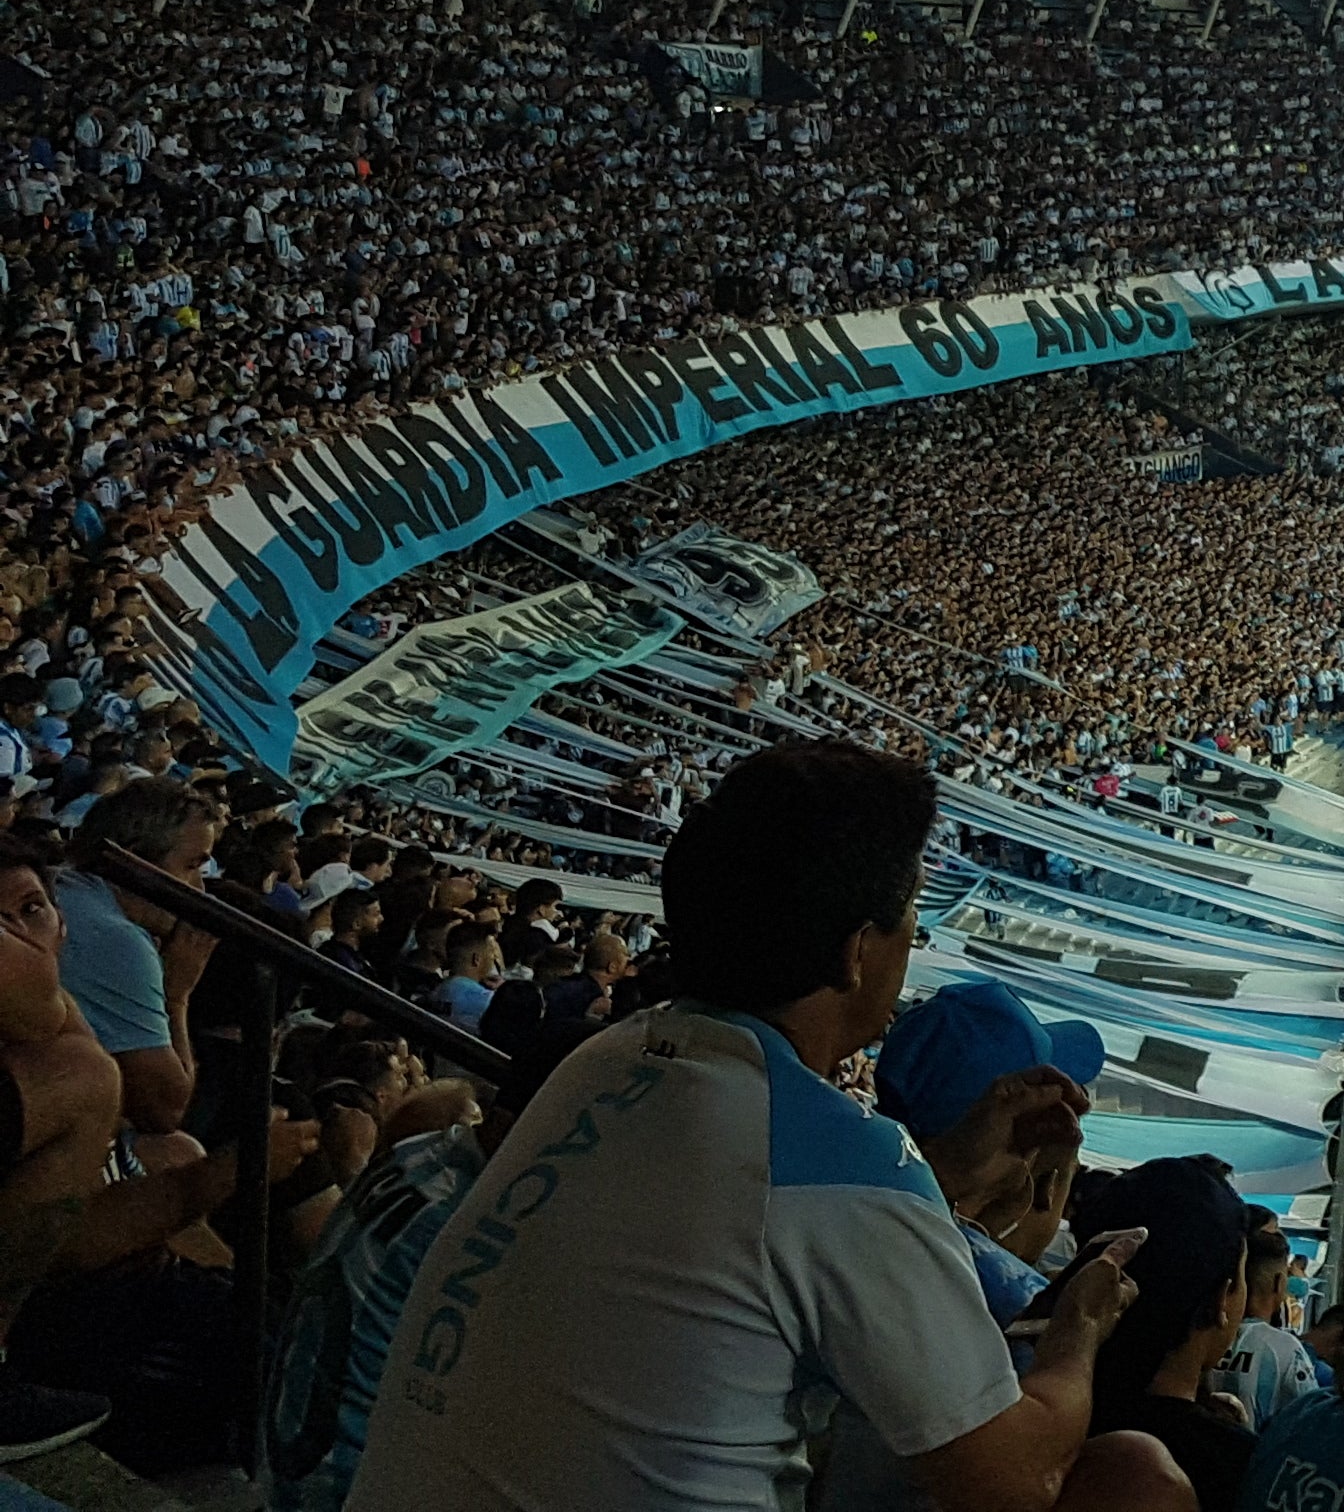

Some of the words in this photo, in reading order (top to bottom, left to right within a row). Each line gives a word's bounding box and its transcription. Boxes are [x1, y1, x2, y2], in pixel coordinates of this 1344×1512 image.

[243, 387, 563, 594] GUARDIA
[540, 314, 902, 468] IMPERIAL
[899, 300, 1000, 378] 60
[414, 1065, 664, 1376] RACING
